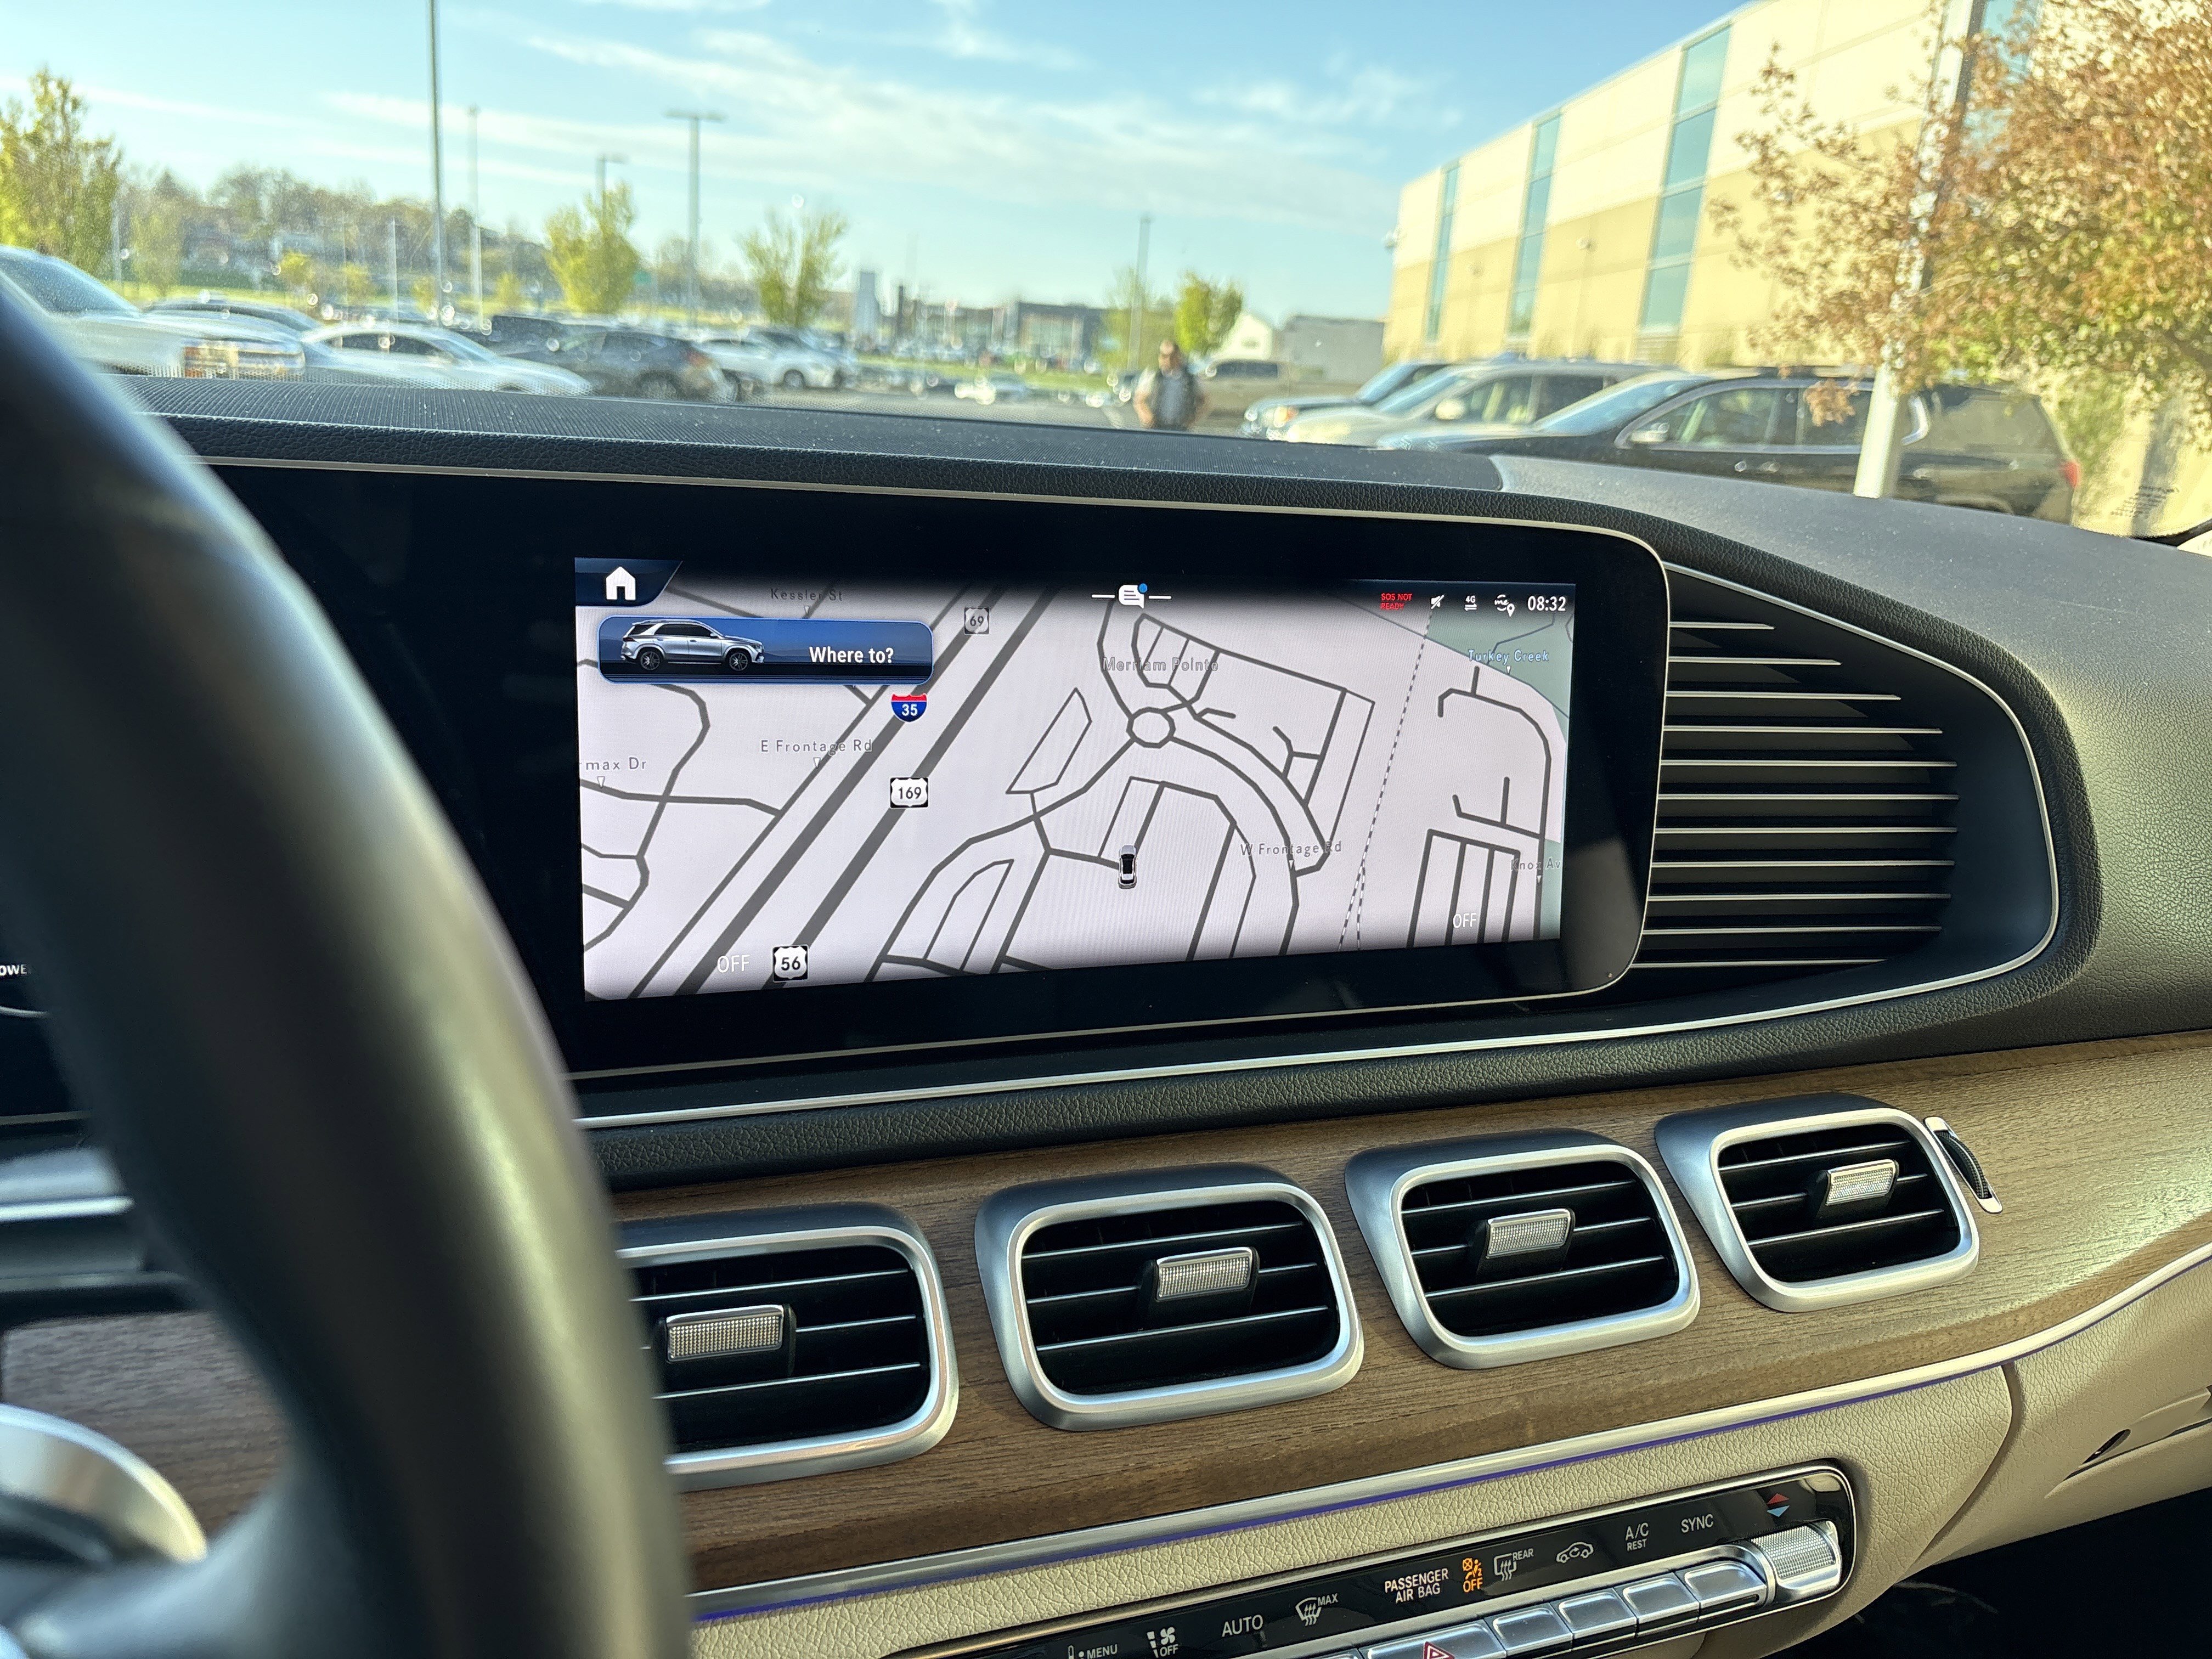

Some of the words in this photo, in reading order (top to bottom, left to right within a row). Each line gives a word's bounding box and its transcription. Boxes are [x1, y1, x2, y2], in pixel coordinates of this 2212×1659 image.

[770, 588, 825, 601] Kessler
[829, 589, 843, 601] St
[1380, 593, 1396, 601] SOS
[1397, 593, 1413, 601] NOT
[1380, 602, 1404, 611] READY
[1527, 596, 1566, 611] 08:32
[969, 614, 985, 628] 69
[809, 646, 864, 664] Where
[868, 647, 894, 664] to?
[1468, 650, 1510, 665] Turkey
[1514, 650, 1549, 662] Creek
[1102, 657, 1167, 672] Merriam
[1172, 657, 1219, 672] Pointe
[901, 703, 918, 716] 35
[760, 741, 769, 753] E
[776, 740, 846, 755] Frontage
[853, 739, 873, 752] Rd
[580, 761, 620, 770] max
[629, 757, 647, 770] Dr
[898, 786, 922, 800] 169
[1240, 843, 1254, 856] W
[1259, 842, 1319, 857] Frontage
[1325, 840, 1342, 854] Rd
[1511, 857, 1542, 872] Knox
[1452, 913, 1477, 928] OFF
[0, 964, 29, 976] OWE
[716, 954, 751, 973] OFF
[781, 956, 801, 972] 56
[1680, 1513, 1714, 1534] SYNC
[1625, 1522, 1649, 1541] A/C
[1627, 1538, 1647, 1551] REST
[1513, 1548, 1534, 1561] REAR
[1384, 1568, 1449, 1593] PASSENGER
[1463, 1577, 1483, 1593] OFF
[1317, 1593, 1339, 1606] MAX
[1395, 1590, 1414, 1604] AIR
[1418, 1582, 1441, 1599] BAG
[1221, 1615, 1263, 1638] AUTO
[1086, 1644, 1118, 1659] MENU
[1160, 1644, 1179, 1657] OFF
